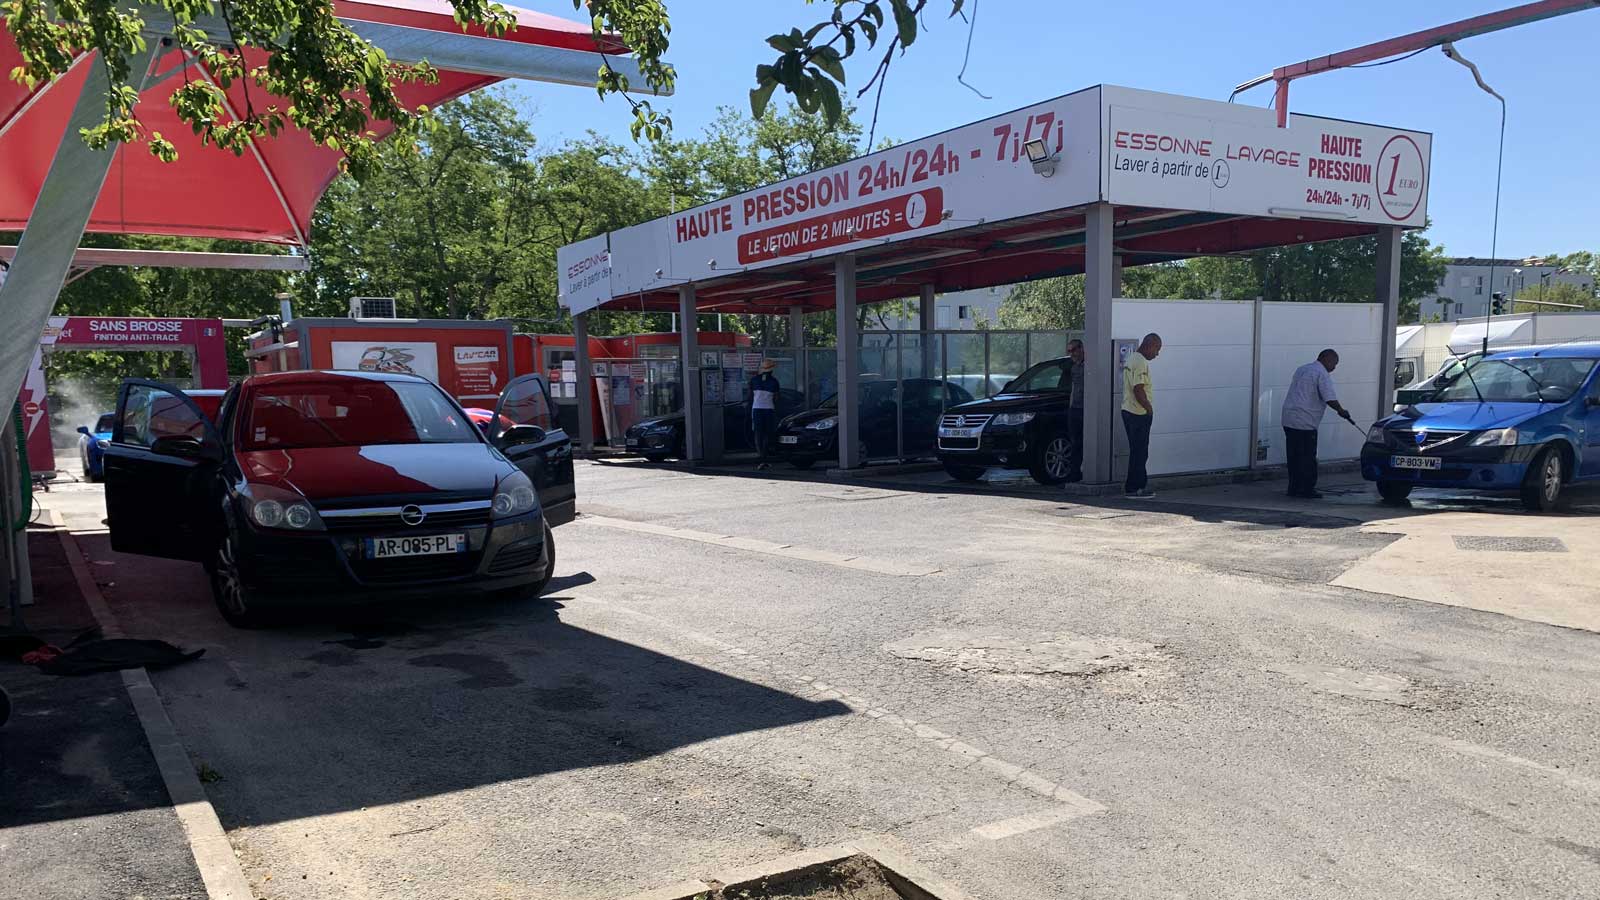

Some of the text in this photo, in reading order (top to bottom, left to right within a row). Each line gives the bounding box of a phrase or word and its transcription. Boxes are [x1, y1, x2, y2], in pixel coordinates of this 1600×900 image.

[1114, 131, 1301, 167] ESSONNE LAVAGE
[1321, 133, 1362, 158] HAUTE
[1114, 153, 1150, 173] Laver
[1151, 157, 1159, 174] à
[1162, 159, 1193, 178] partir
[1195, 161, 1209, 178] de
[1308, 157, 1372, 184] PRESSION
[1383, 153, 1418, 196] 1 EURO
[676, 204, 733, 243] HAUTE
[743, 170, 849, 226] PRESSION
[857, 143, 960, 197] 24h/24h
[1306, 188, 1342, 206] 24h/24h
[1351, 193, 1371, 211] 7j/7j
[748, 239, 761, 256] LE
[763, 230, 799, 253] JETON
[802, 225, 818, 244] DE
[821, 223, 828, 240] 2
[831, 208, 890, 238] MINUTES
[568, 248, 608, 280] ESSONNE
[89, 320, 183, 332] SANS BROSSE
[94, 333, 180, 342] FINITION ANTI-TRACE
